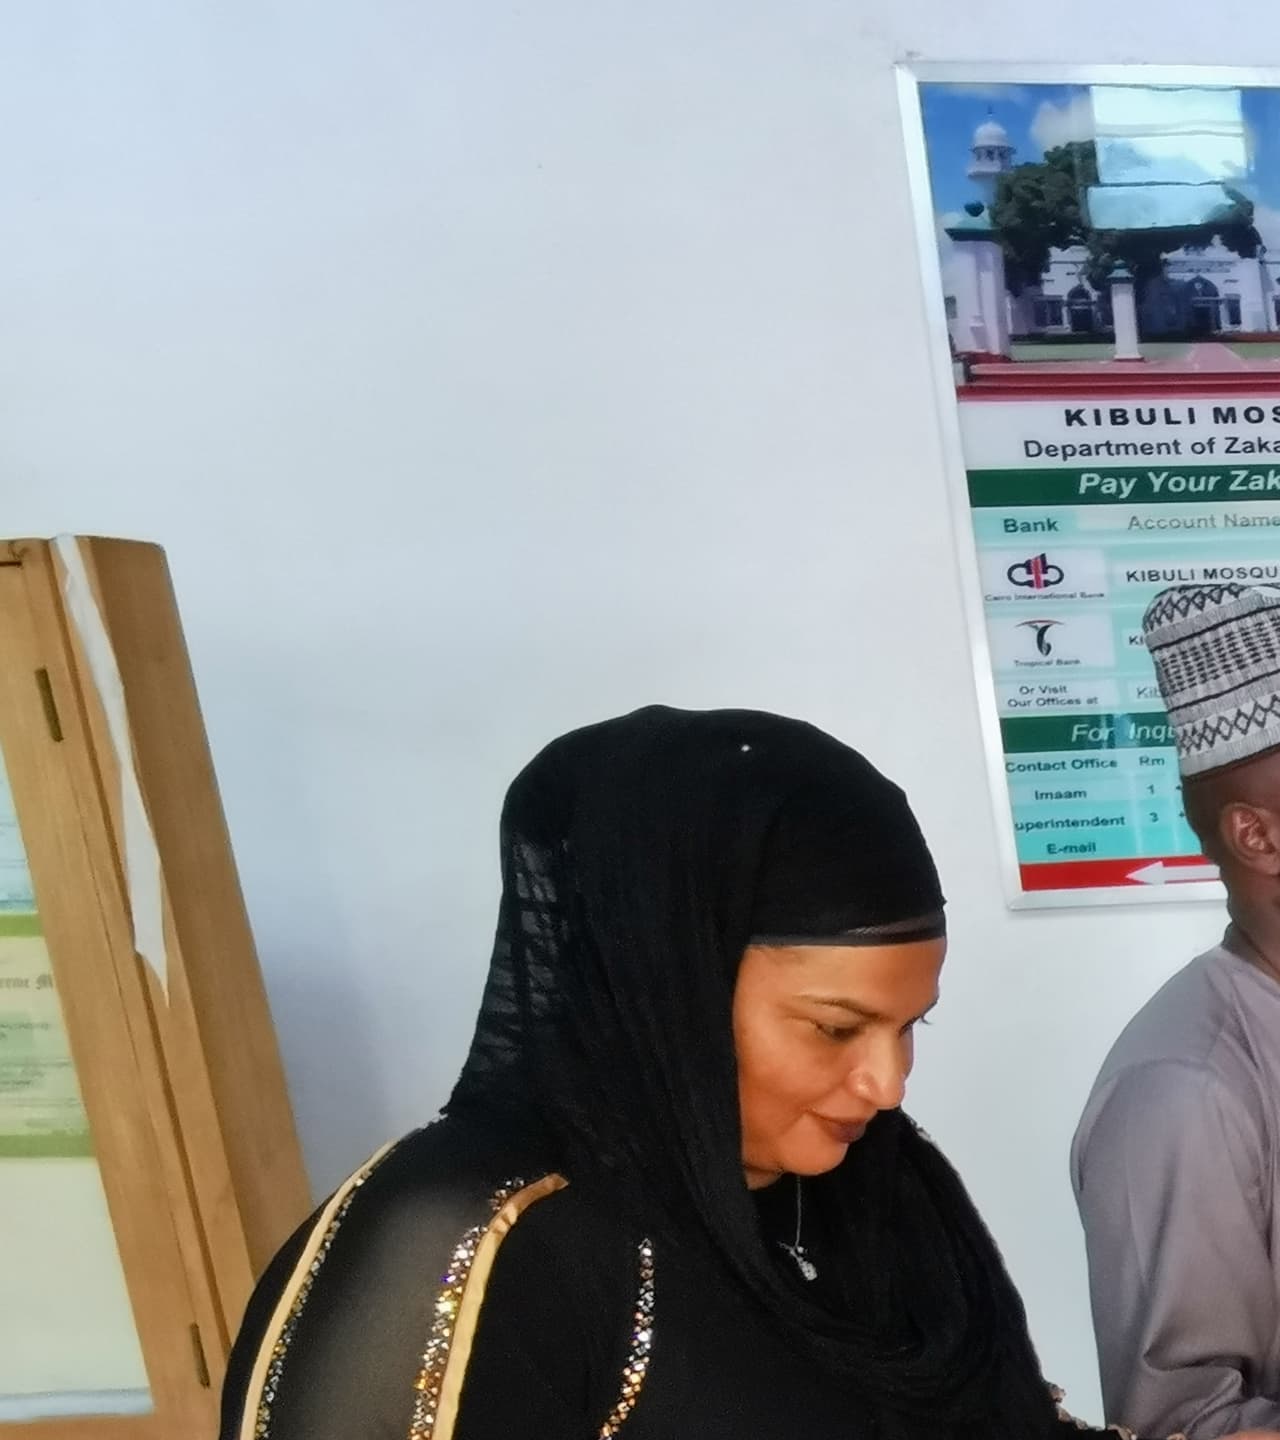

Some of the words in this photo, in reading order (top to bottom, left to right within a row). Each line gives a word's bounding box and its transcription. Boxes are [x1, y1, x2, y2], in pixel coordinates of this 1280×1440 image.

[1065, 406, 1196, 427] KIBULI
[1024, 438, 1182, 462] Department
[1191, 436, 1216, 455] of
[1079, 472, 1137, 499] Pay
[1148, 471, 1221, 493] Your
[1003, 517, 1059, 534] Bank
[1128, 513, 1217, 531] Account
[1126, 567, 1196, 583] KIBULI
[1019, 686, 1035, 696] Or
[1039, 684, 1068, 695] Visit
[1007, 697, 1032, 708] Our
[1036, 696, 1082, 707] Offices
[1071, 722, 1115, 743] For
[1005, 758, 1067, 773] Contact
[1071, 757, 1118, 770] Office
[1139, 755, 1166, 767] Rm
[1034, 788, 1087, 801] Imaam
[1014, 816, 1126, 831] uperintendent
[1046, 841, 1097, 855] E-mail
